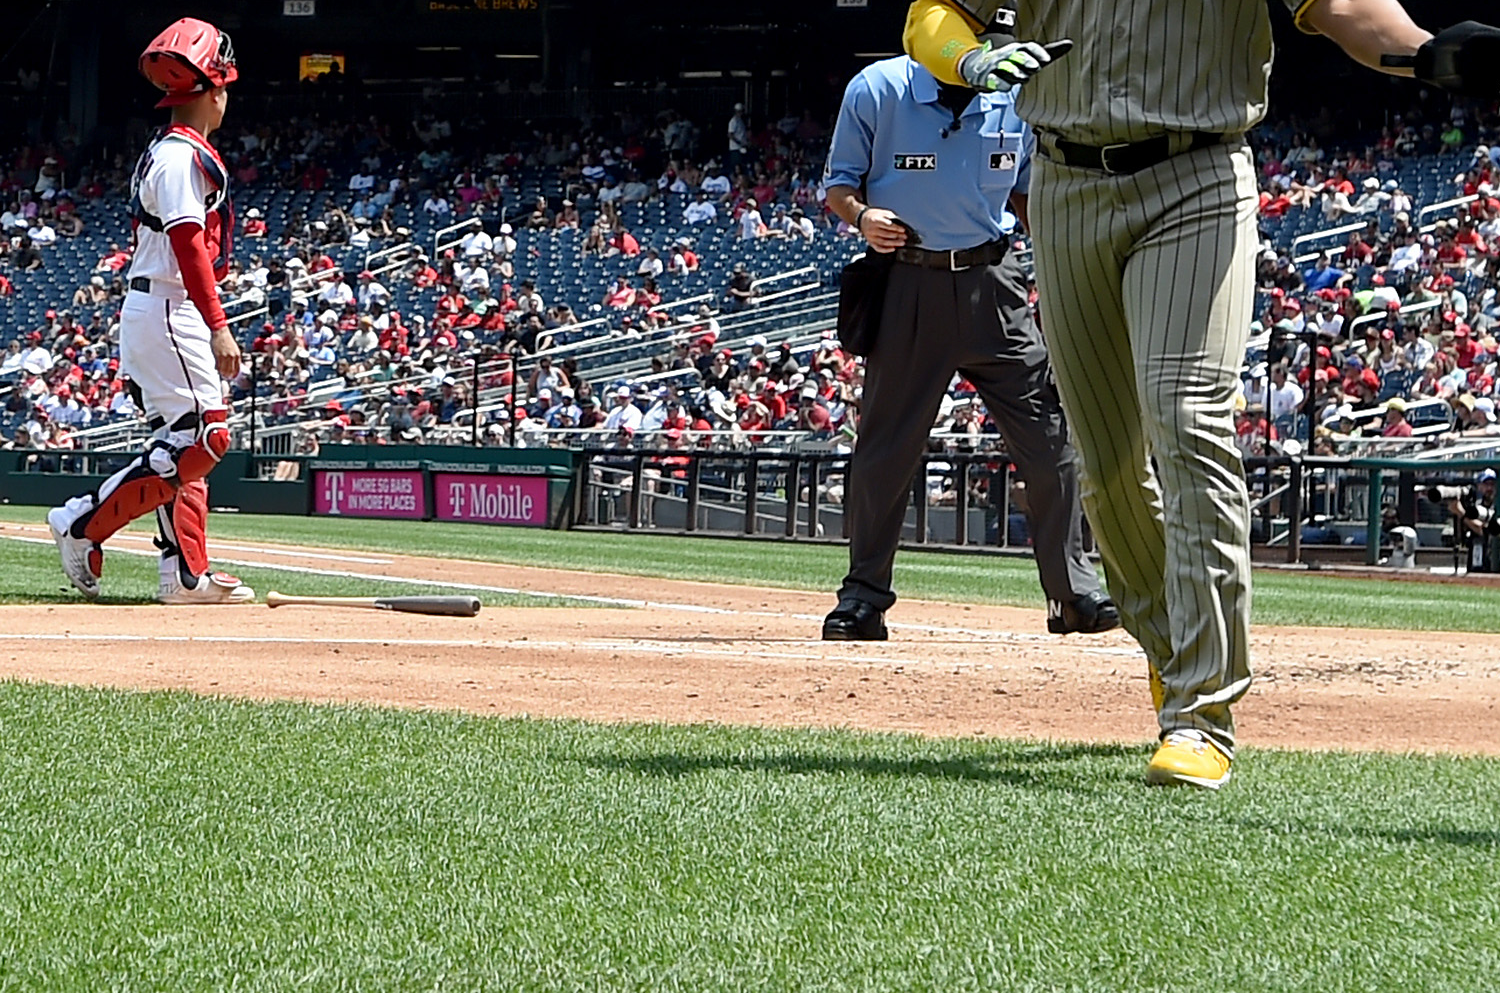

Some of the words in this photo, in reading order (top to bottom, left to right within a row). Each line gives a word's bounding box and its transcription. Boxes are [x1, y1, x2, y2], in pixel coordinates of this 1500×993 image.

[290, 1, 311, 13] 136
[905, 156, 935, 168] FTX
[352, 478, 376, 492] MORE
[377, 478, 389, 492] 5G
[390, 478, 413, 493] BARS
[348, 494, 358, 508] IN
[359, 494, 383, 510] MORE
[384, 495, 416, 511] PLACES
[469, 483, 533, 520] Mobile
